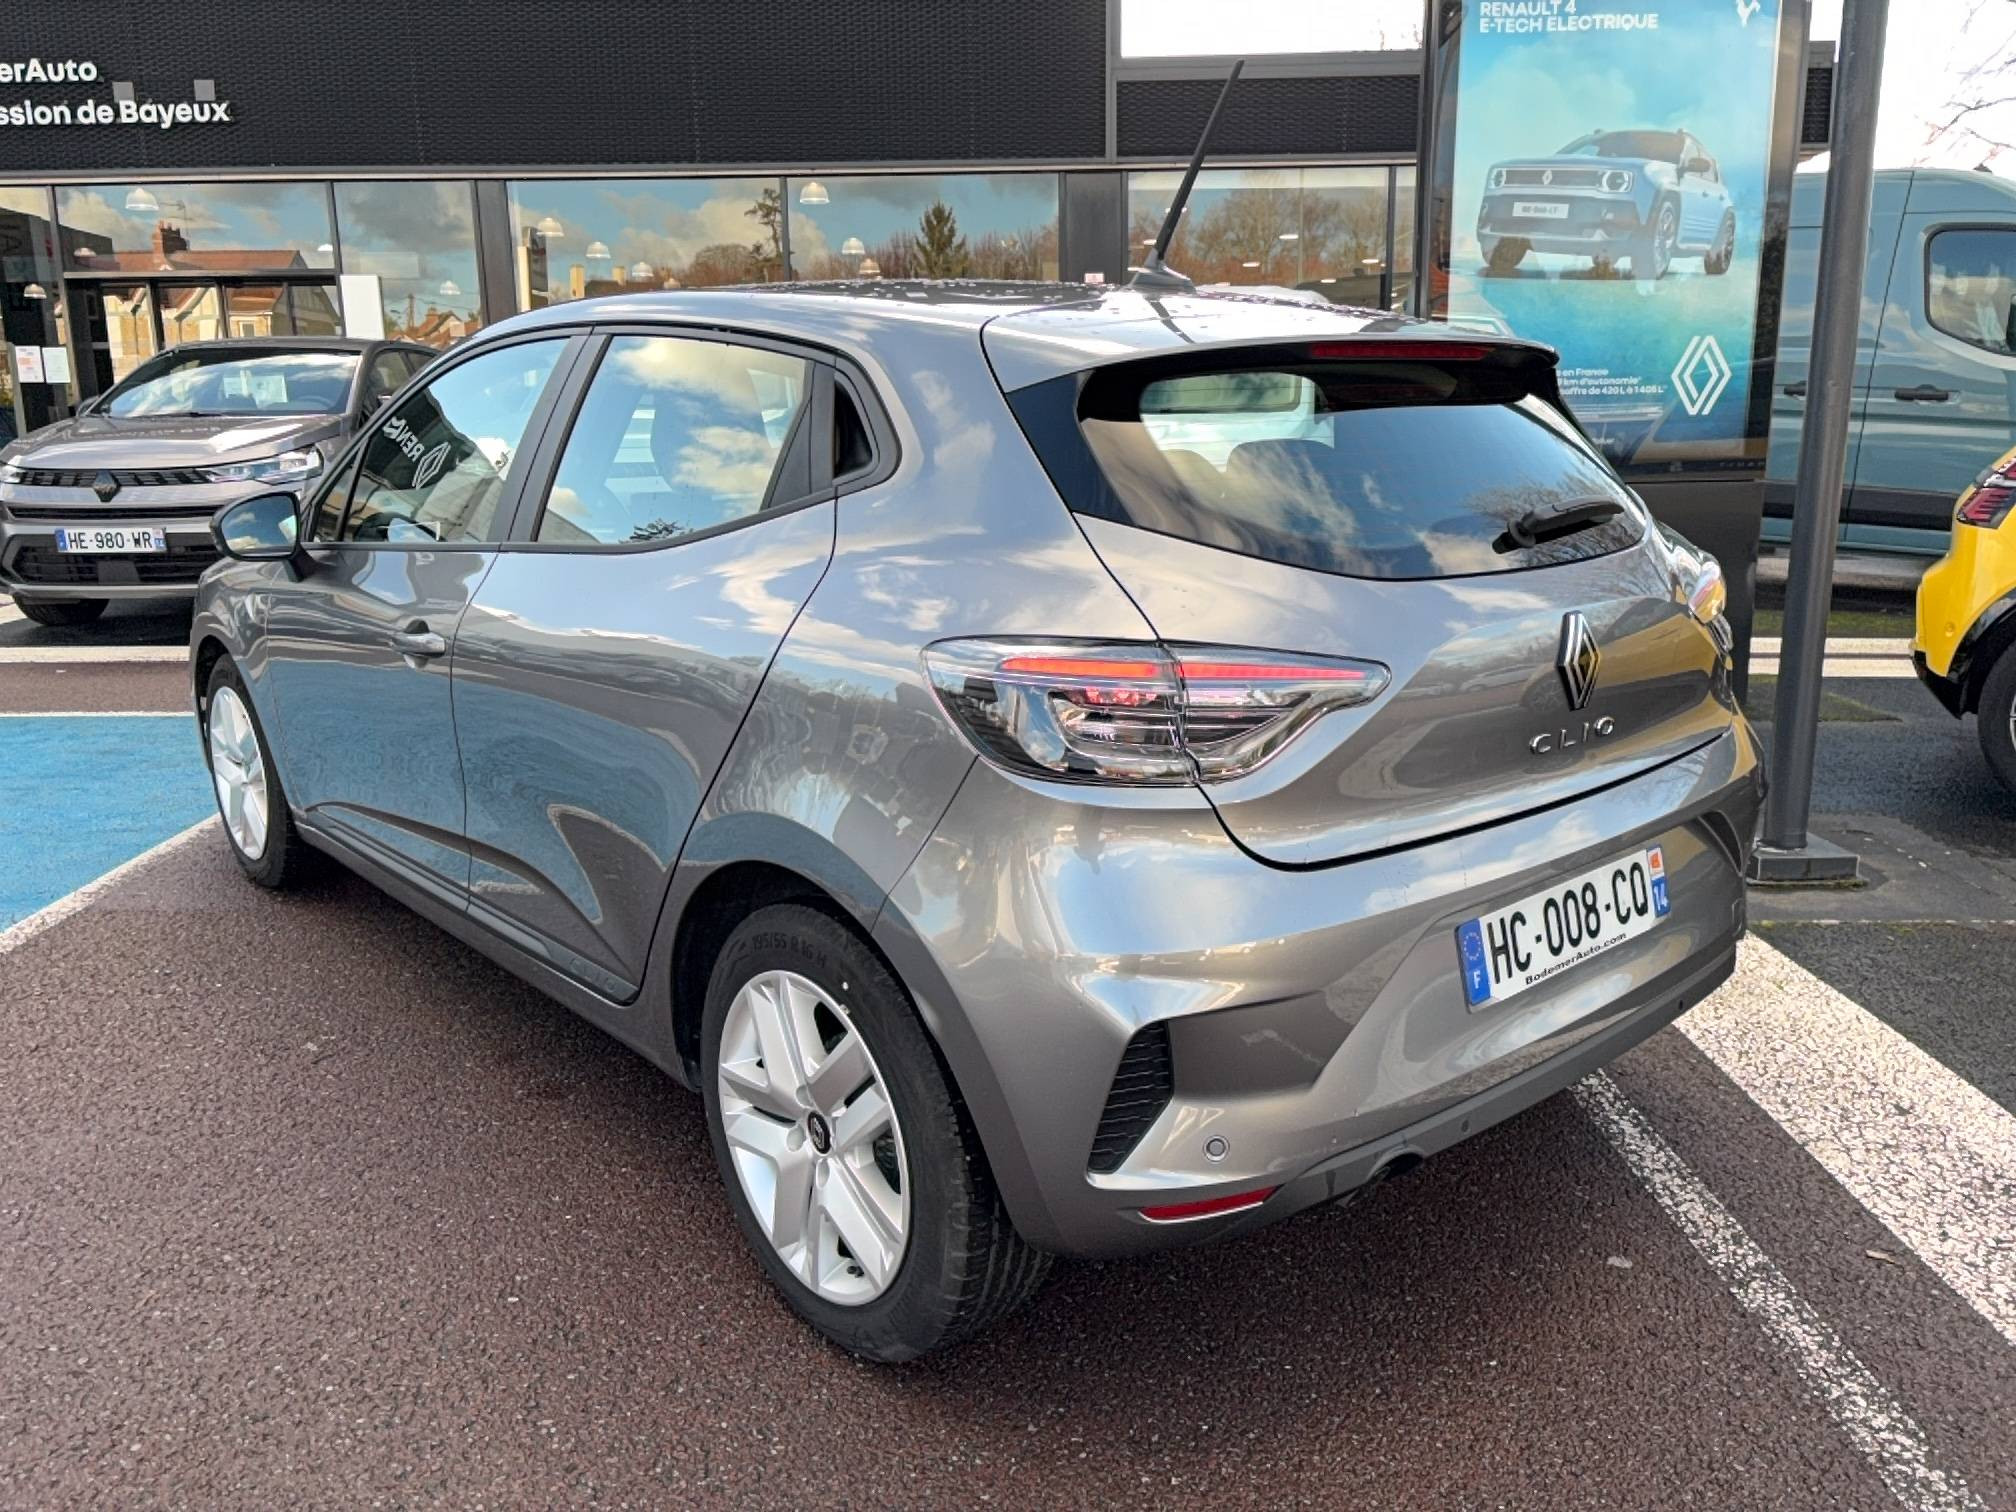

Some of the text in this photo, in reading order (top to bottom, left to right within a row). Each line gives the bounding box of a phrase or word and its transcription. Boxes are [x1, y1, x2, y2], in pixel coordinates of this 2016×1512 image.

[1480, 0, 1577, 16] RENAULT 4
[1480, 17, 1543, 33] E-TECH
[0, 58, 98, 83] erAuto
[77, 99, 114, 124] de
[118, 99, 231, 129] Bayeux
[67, 531, 153, 550] HE-980-WR
[1529, 716, 1616, 755] CLIO
[1487, 862, 1649, 984] HC-008-CQ
[1525, 933, 1628, 986] BodemerAuto.com
[1473, 969, 1481, 989] F
